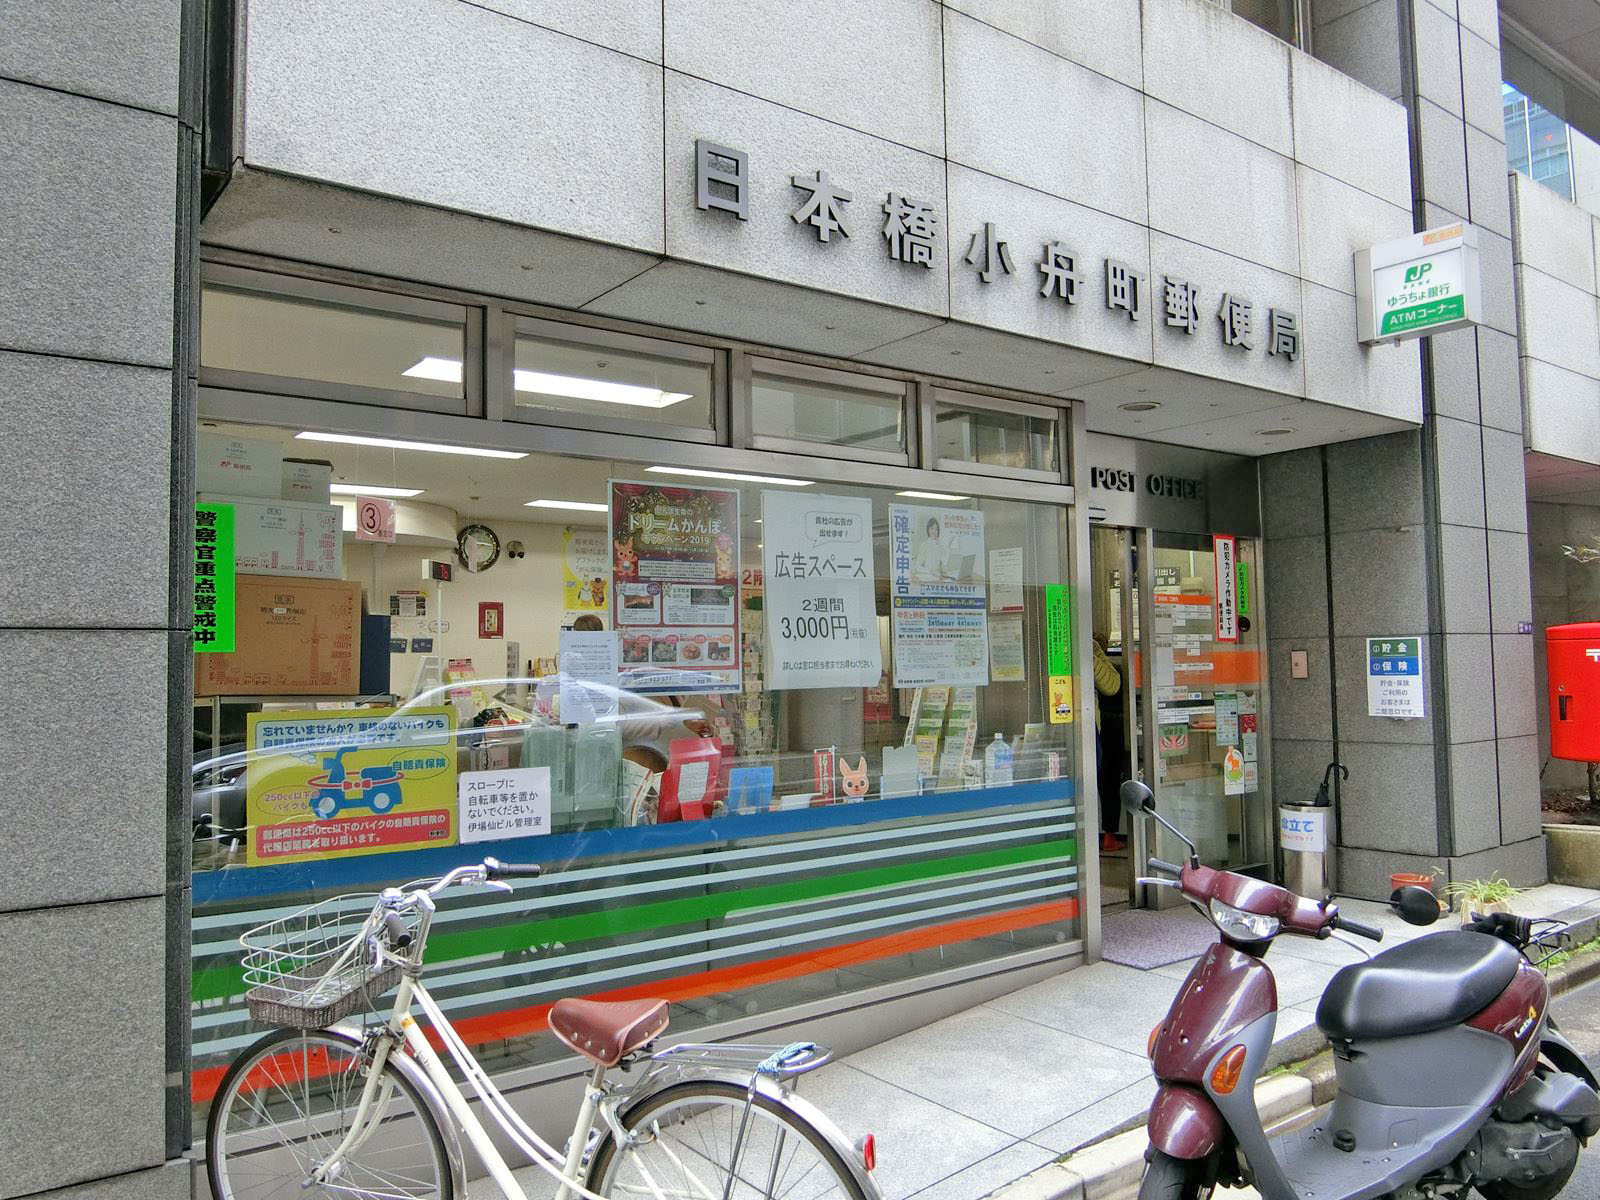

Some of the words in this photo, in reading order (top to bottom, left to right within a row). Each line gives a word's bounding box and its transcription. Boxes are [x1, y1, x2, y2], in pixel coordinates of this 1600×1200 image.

[694, 138, 1301, 362] 日本橋小舟町郵便局
[1387, 283, 1450, 307] ゆうちょ銀行
[1389, 303, 1457, 325] ATMコーナー
[1091, 466, 1135, 493] POST
[628, 513, 722, 535] ドリームかんぽ
[690, 535, 709, 545] 2019
[774, 550, 867, 580] 広告スペース
[893, 515, 911, 595] 確定申告
[194, 510, 217, 645] 警察官重点警戒中
[1223, 542, 1232, 636] 防犯カメラ作動中です
[392, 758, 446, 772] 自賠責保険
[264, 790, 320, 802] 250cc以下の
[467, 778, 515, 792] スロープに
[468, 790, 539, 807] 自転車等を置か
[468, 805, 535, 819] ないでください。
[468, 816, 543, 833] 伊場仙ビル管理室
[1281, 816, 1314, 833] 傘立て
